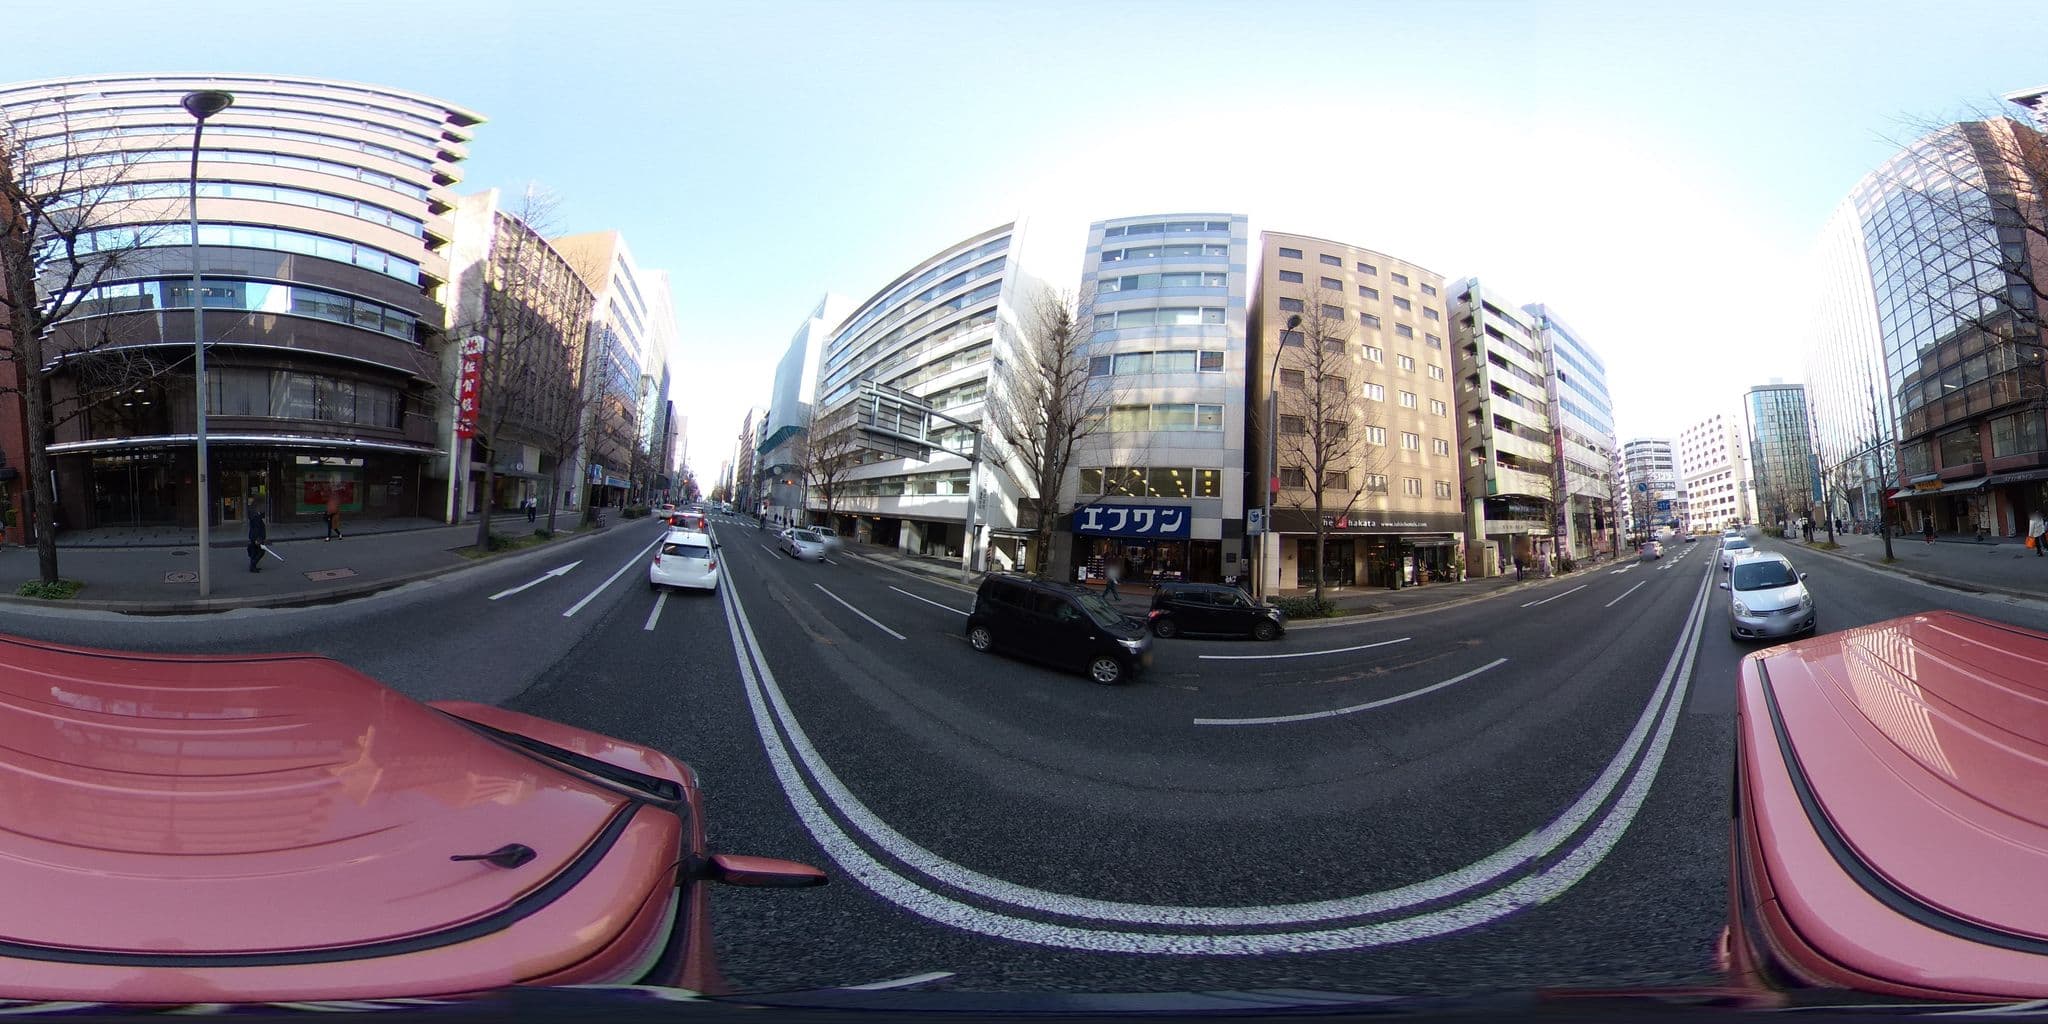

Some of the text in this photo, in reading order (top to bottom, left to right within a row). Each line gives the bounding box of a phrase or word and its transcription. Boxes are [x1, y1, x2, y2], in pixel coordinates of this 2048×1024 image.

[460, 360, 476, 432] 佐賀銀行
[1080, 507, 1183, 533] エフワン
[1348, 519, 1376, 527] hakata
